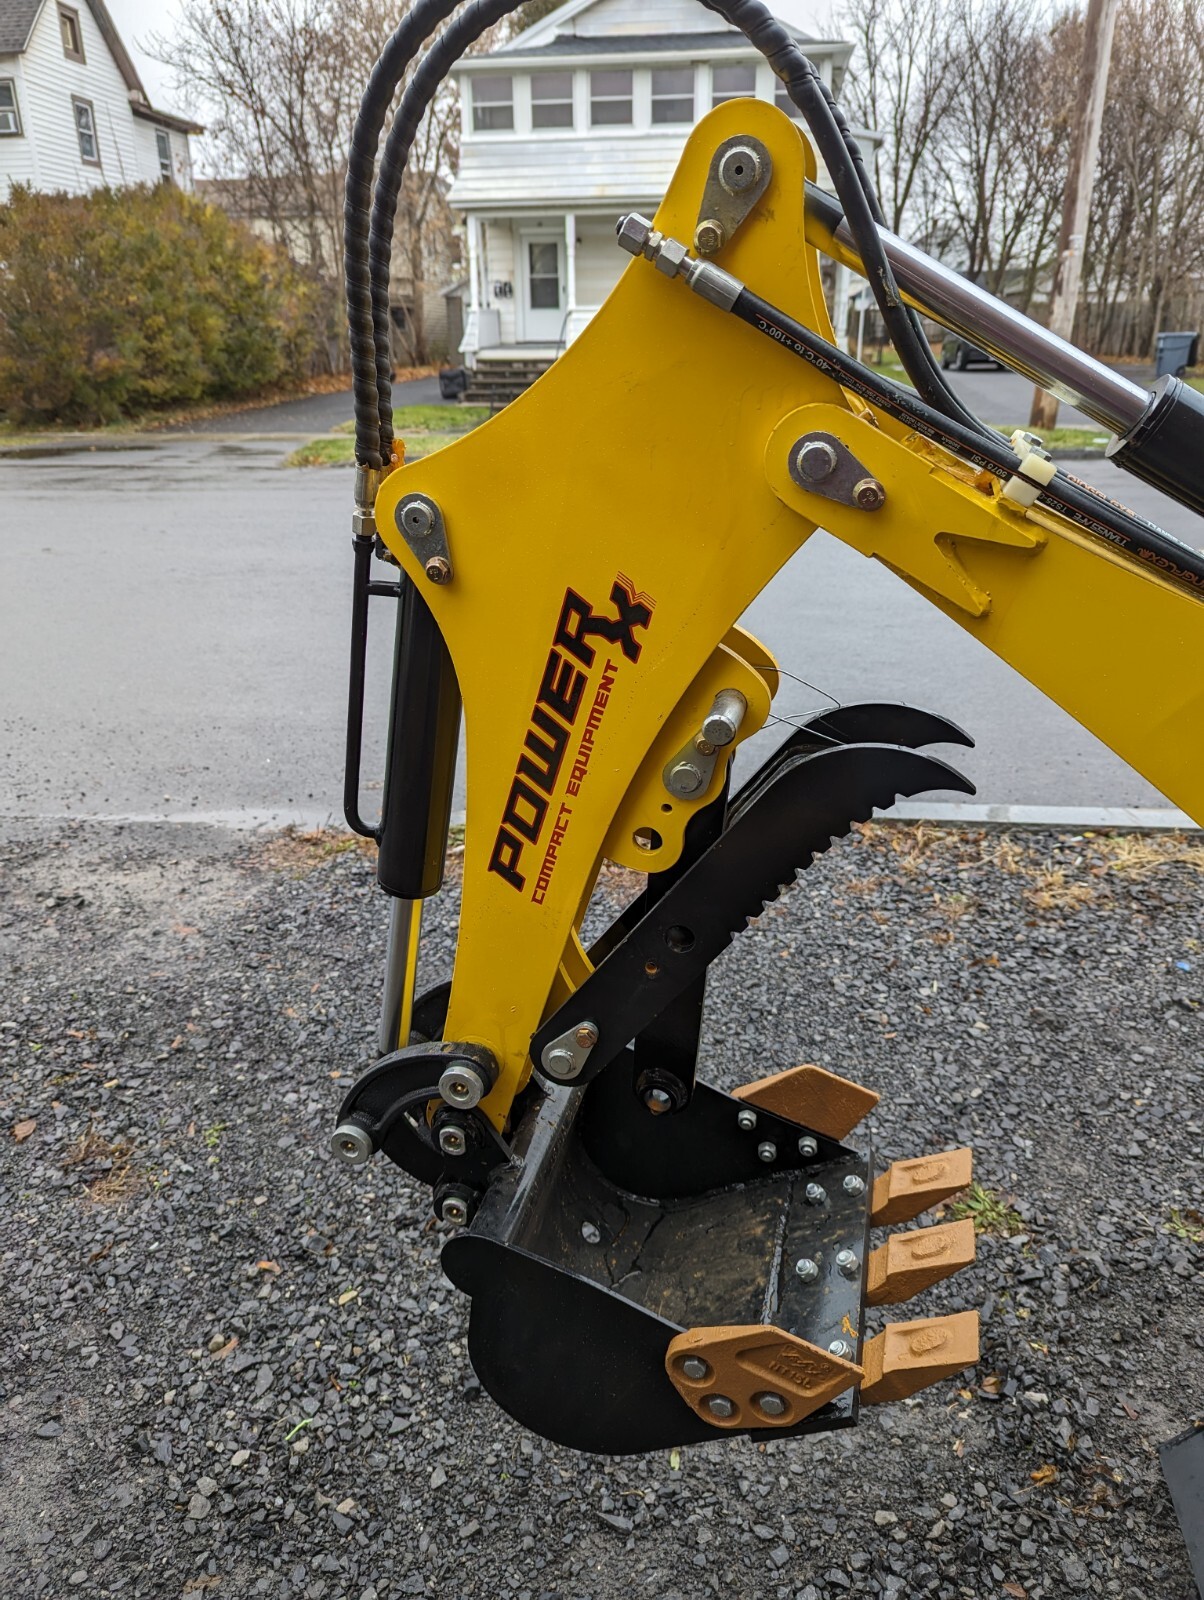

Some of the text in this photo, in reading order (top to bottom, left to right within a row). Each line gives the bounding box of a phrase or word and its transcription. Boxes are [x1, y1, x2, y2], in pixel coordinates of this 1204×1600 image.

[757, 319, 832, 372] -40°C to +100°C
[970, 453, 1008, 479] 5075 PSI
[531, 658, 619, 905] COMPACT EQUIPMENT
